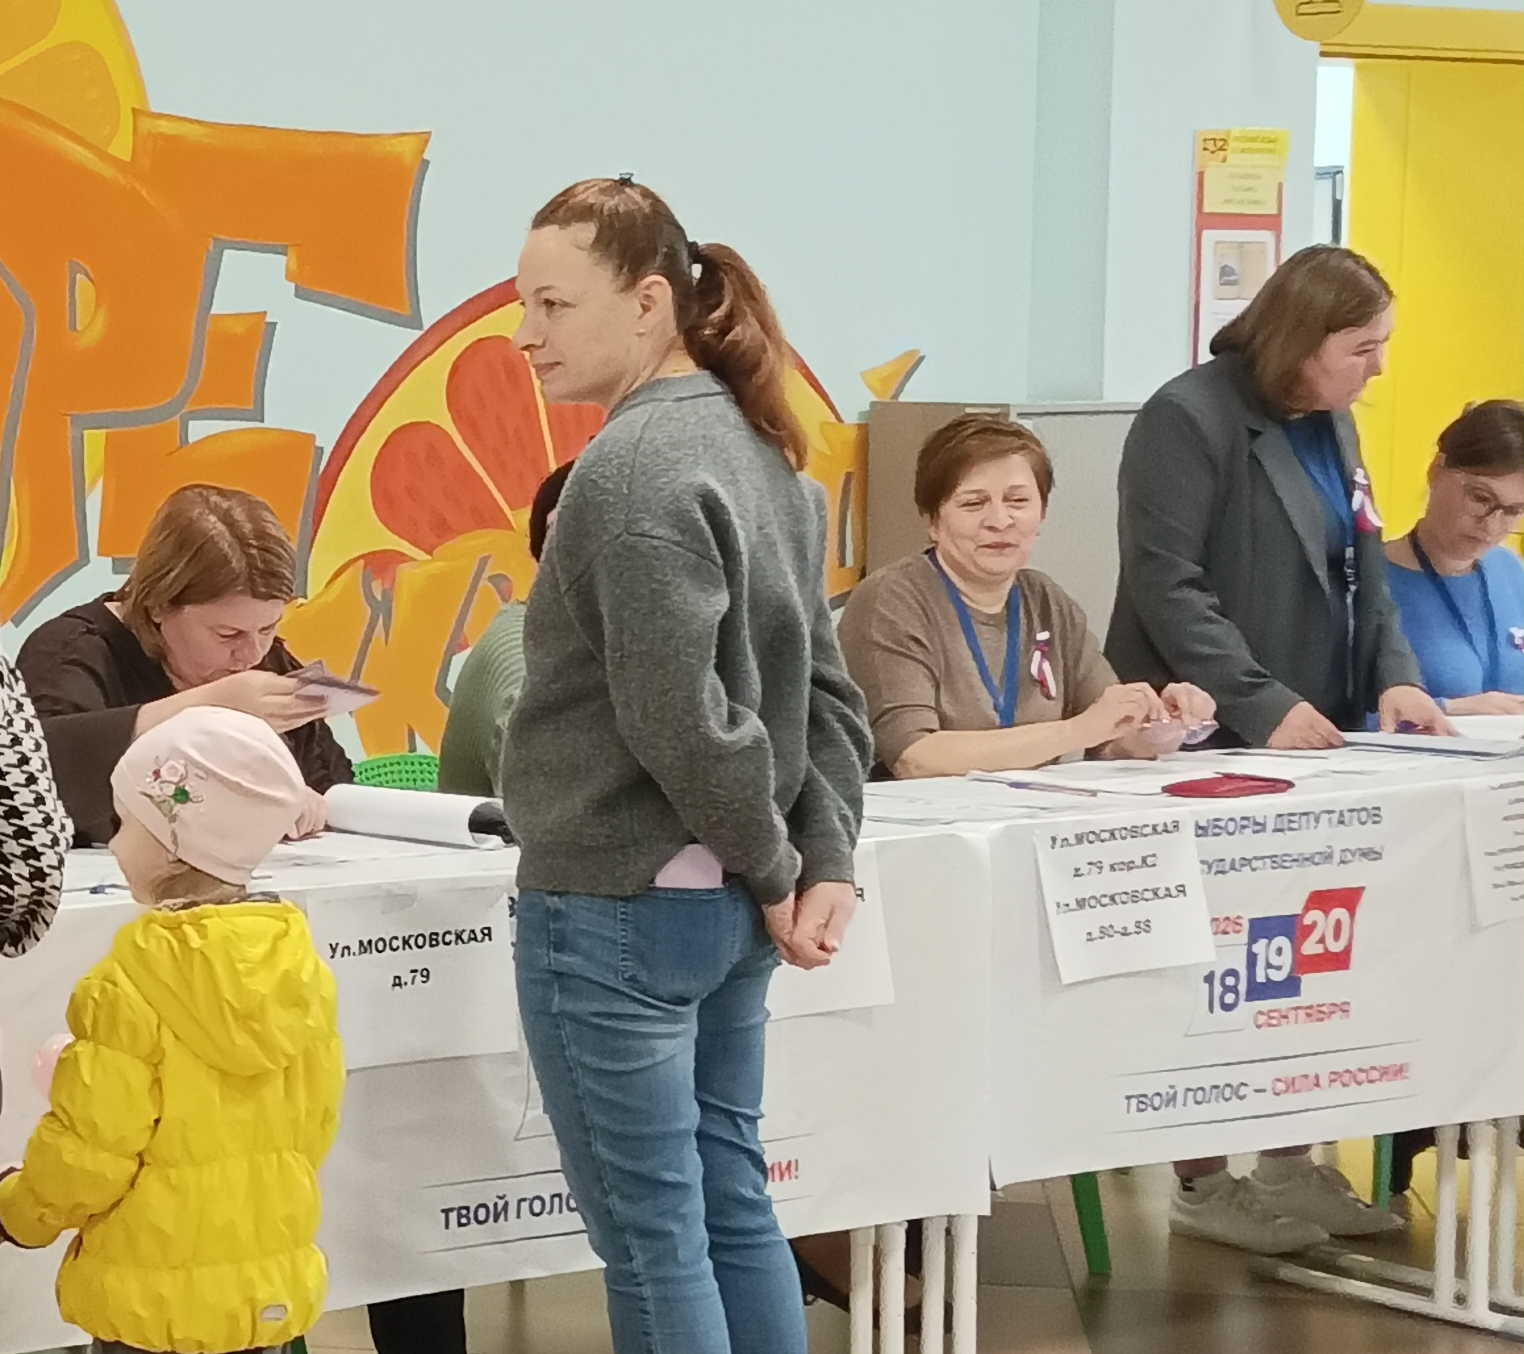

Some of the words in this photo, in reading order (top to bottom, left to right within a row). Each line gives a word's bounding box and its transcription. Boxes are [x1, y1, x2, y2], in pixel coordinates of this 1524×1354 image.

[1272, 806, 1383, 835] ДЕПУТАТОВ
[1199, 845, 1334, 876] УДАРСТВЕННОЙ
[329, 926, 493, 959] Ул.МОСКОВСКАЯ
[1203, 968, 1241, 1014] 18
[1252, 935, 1294, 983] 19
[1300, 907, 1351, 956] 20
[391, 967, 431, 991] д.79
[1253, 1001, 1351, 1030] СЕНТЯБРЯ
[1125, 1084, 1179, 1114] ТВОЙ
[1181, 1082, 1250, 1108] ГОЛОС
[1271, 1072, 1322, 1096] СИЛА
[440, 1193, 509, 1230] ТВОЙ
[516, 1192, 578, 1219] ГОЛО
